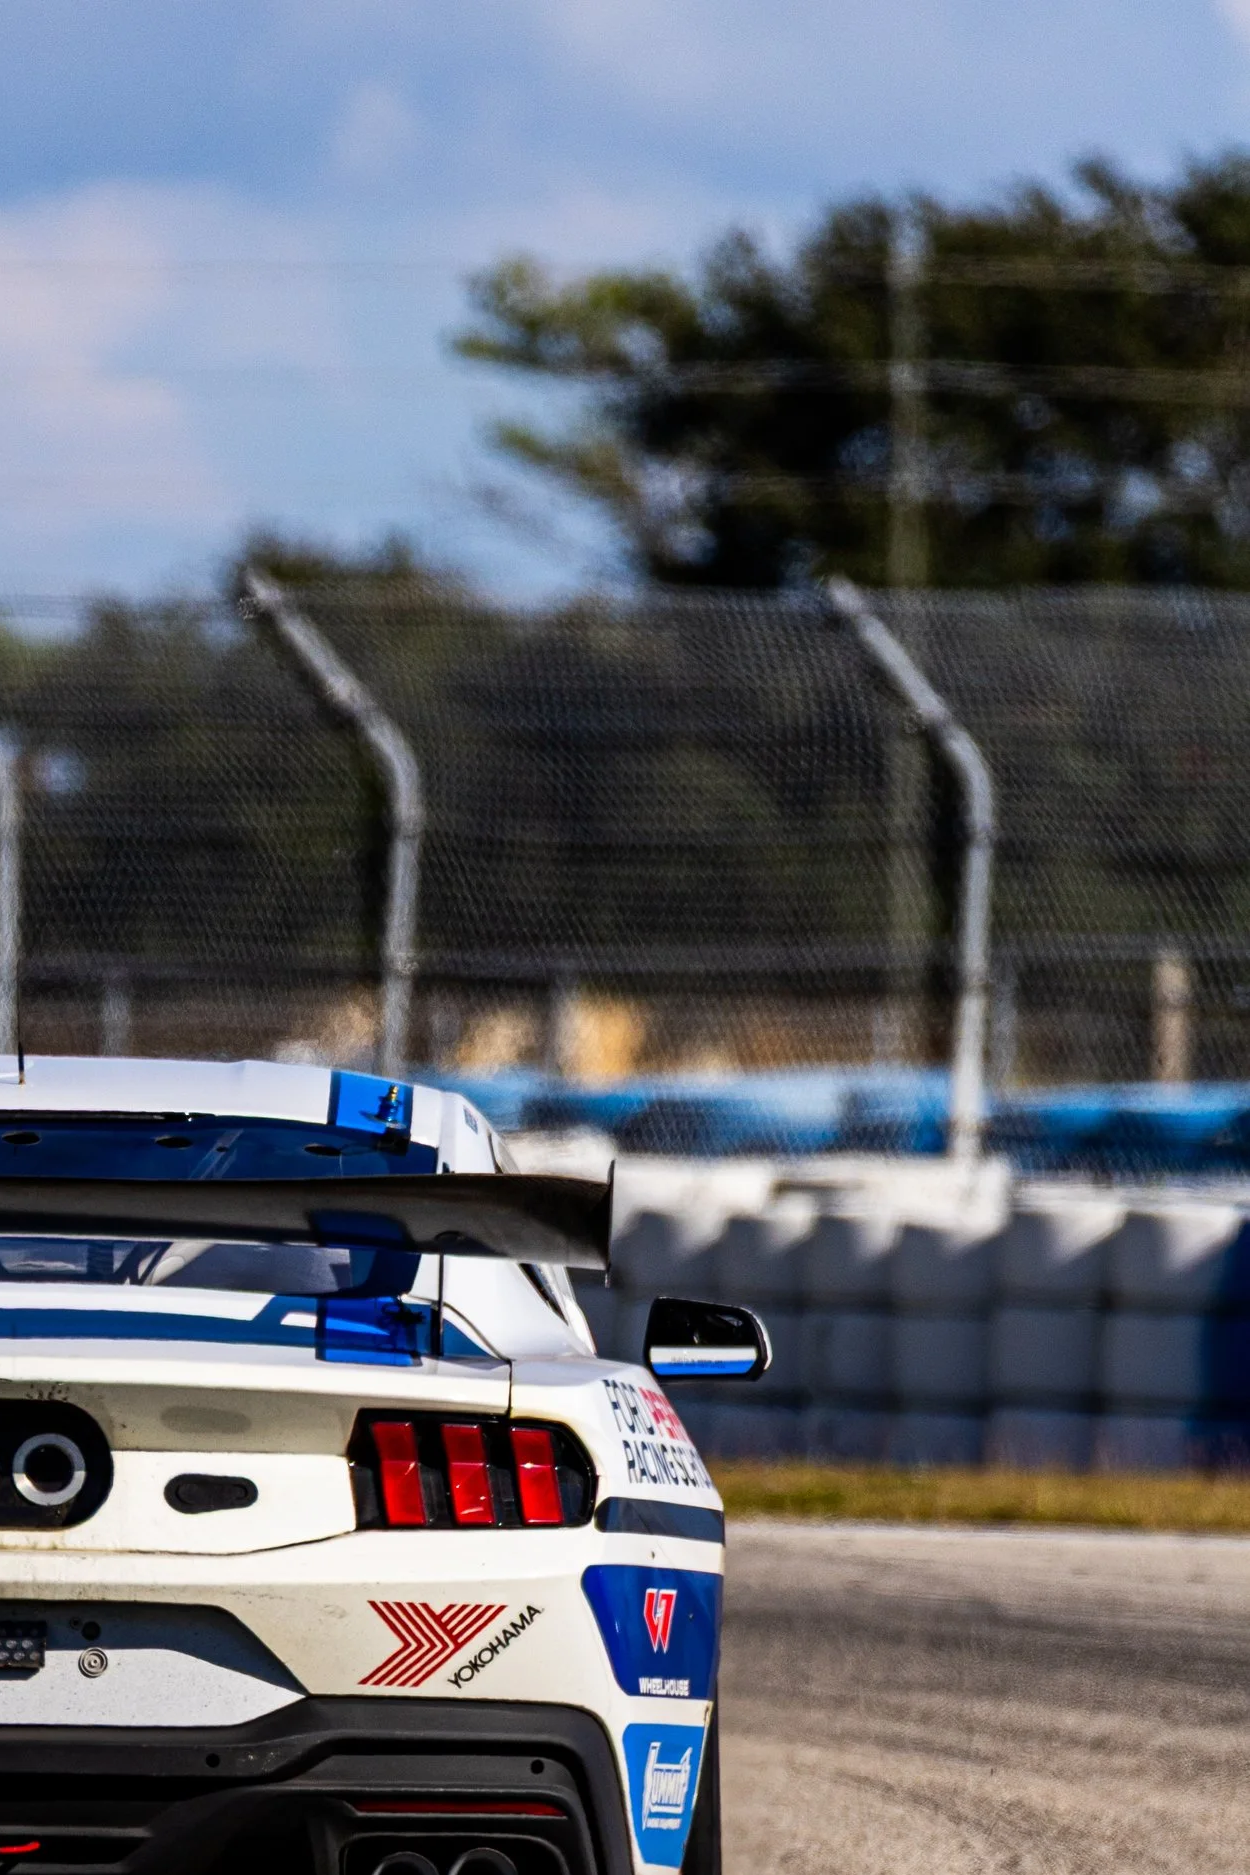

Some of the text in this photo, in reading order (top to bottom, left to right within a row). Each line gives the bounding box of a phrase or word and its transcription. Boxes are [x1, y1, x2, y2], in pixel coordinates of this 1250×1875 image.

[602, 1379, 655, 1434] FORD
[622, 1440, 679, 1485] RACING
[447, 1605, 542, 1689] YOKOHAMA
[638, 1677, 690, 1697] WHEELHOUSE
